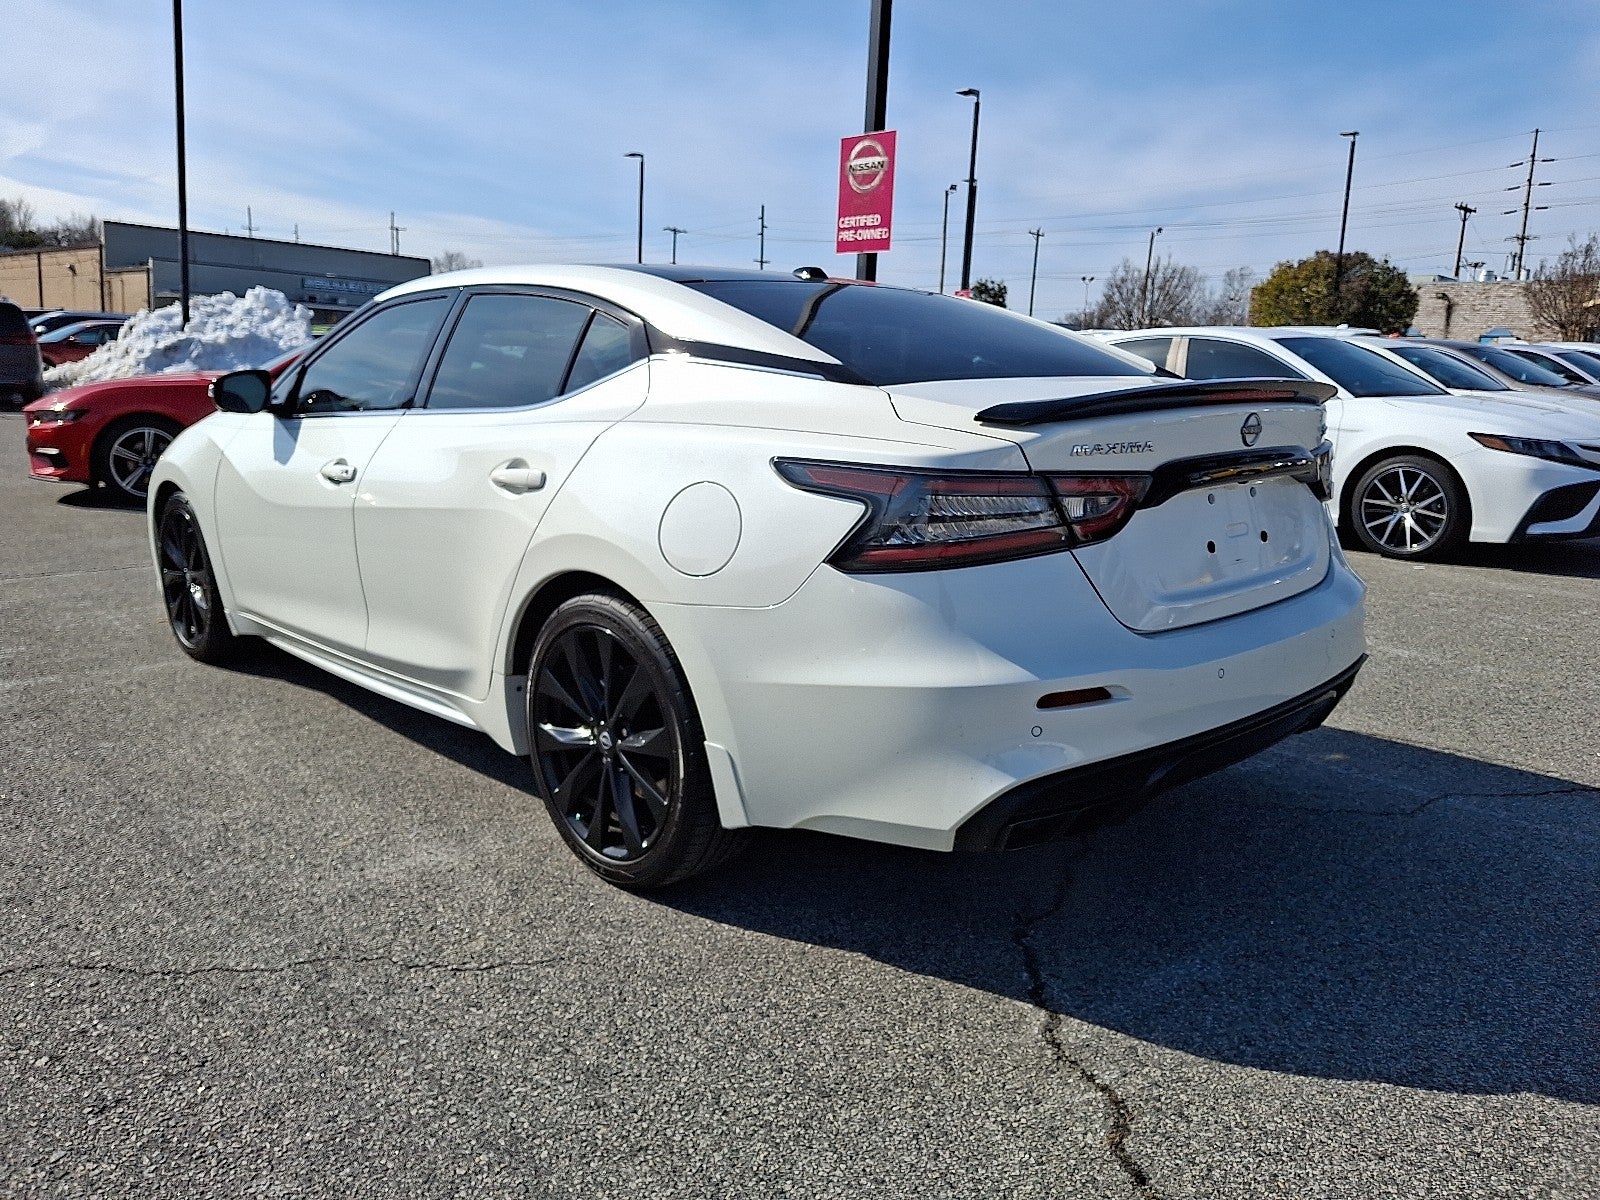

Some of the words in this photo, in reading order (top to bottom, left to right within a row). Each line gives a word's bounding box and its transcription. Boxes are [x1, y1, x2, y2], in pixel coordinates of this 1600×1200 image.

[848, 160, 885, 173] NISSAN
[839, 214, 881, 228] CERTIFIED
[839, 227, 889, 241] PRE-OWNED
[1070, 441, 1154, 457] MAXIMA
